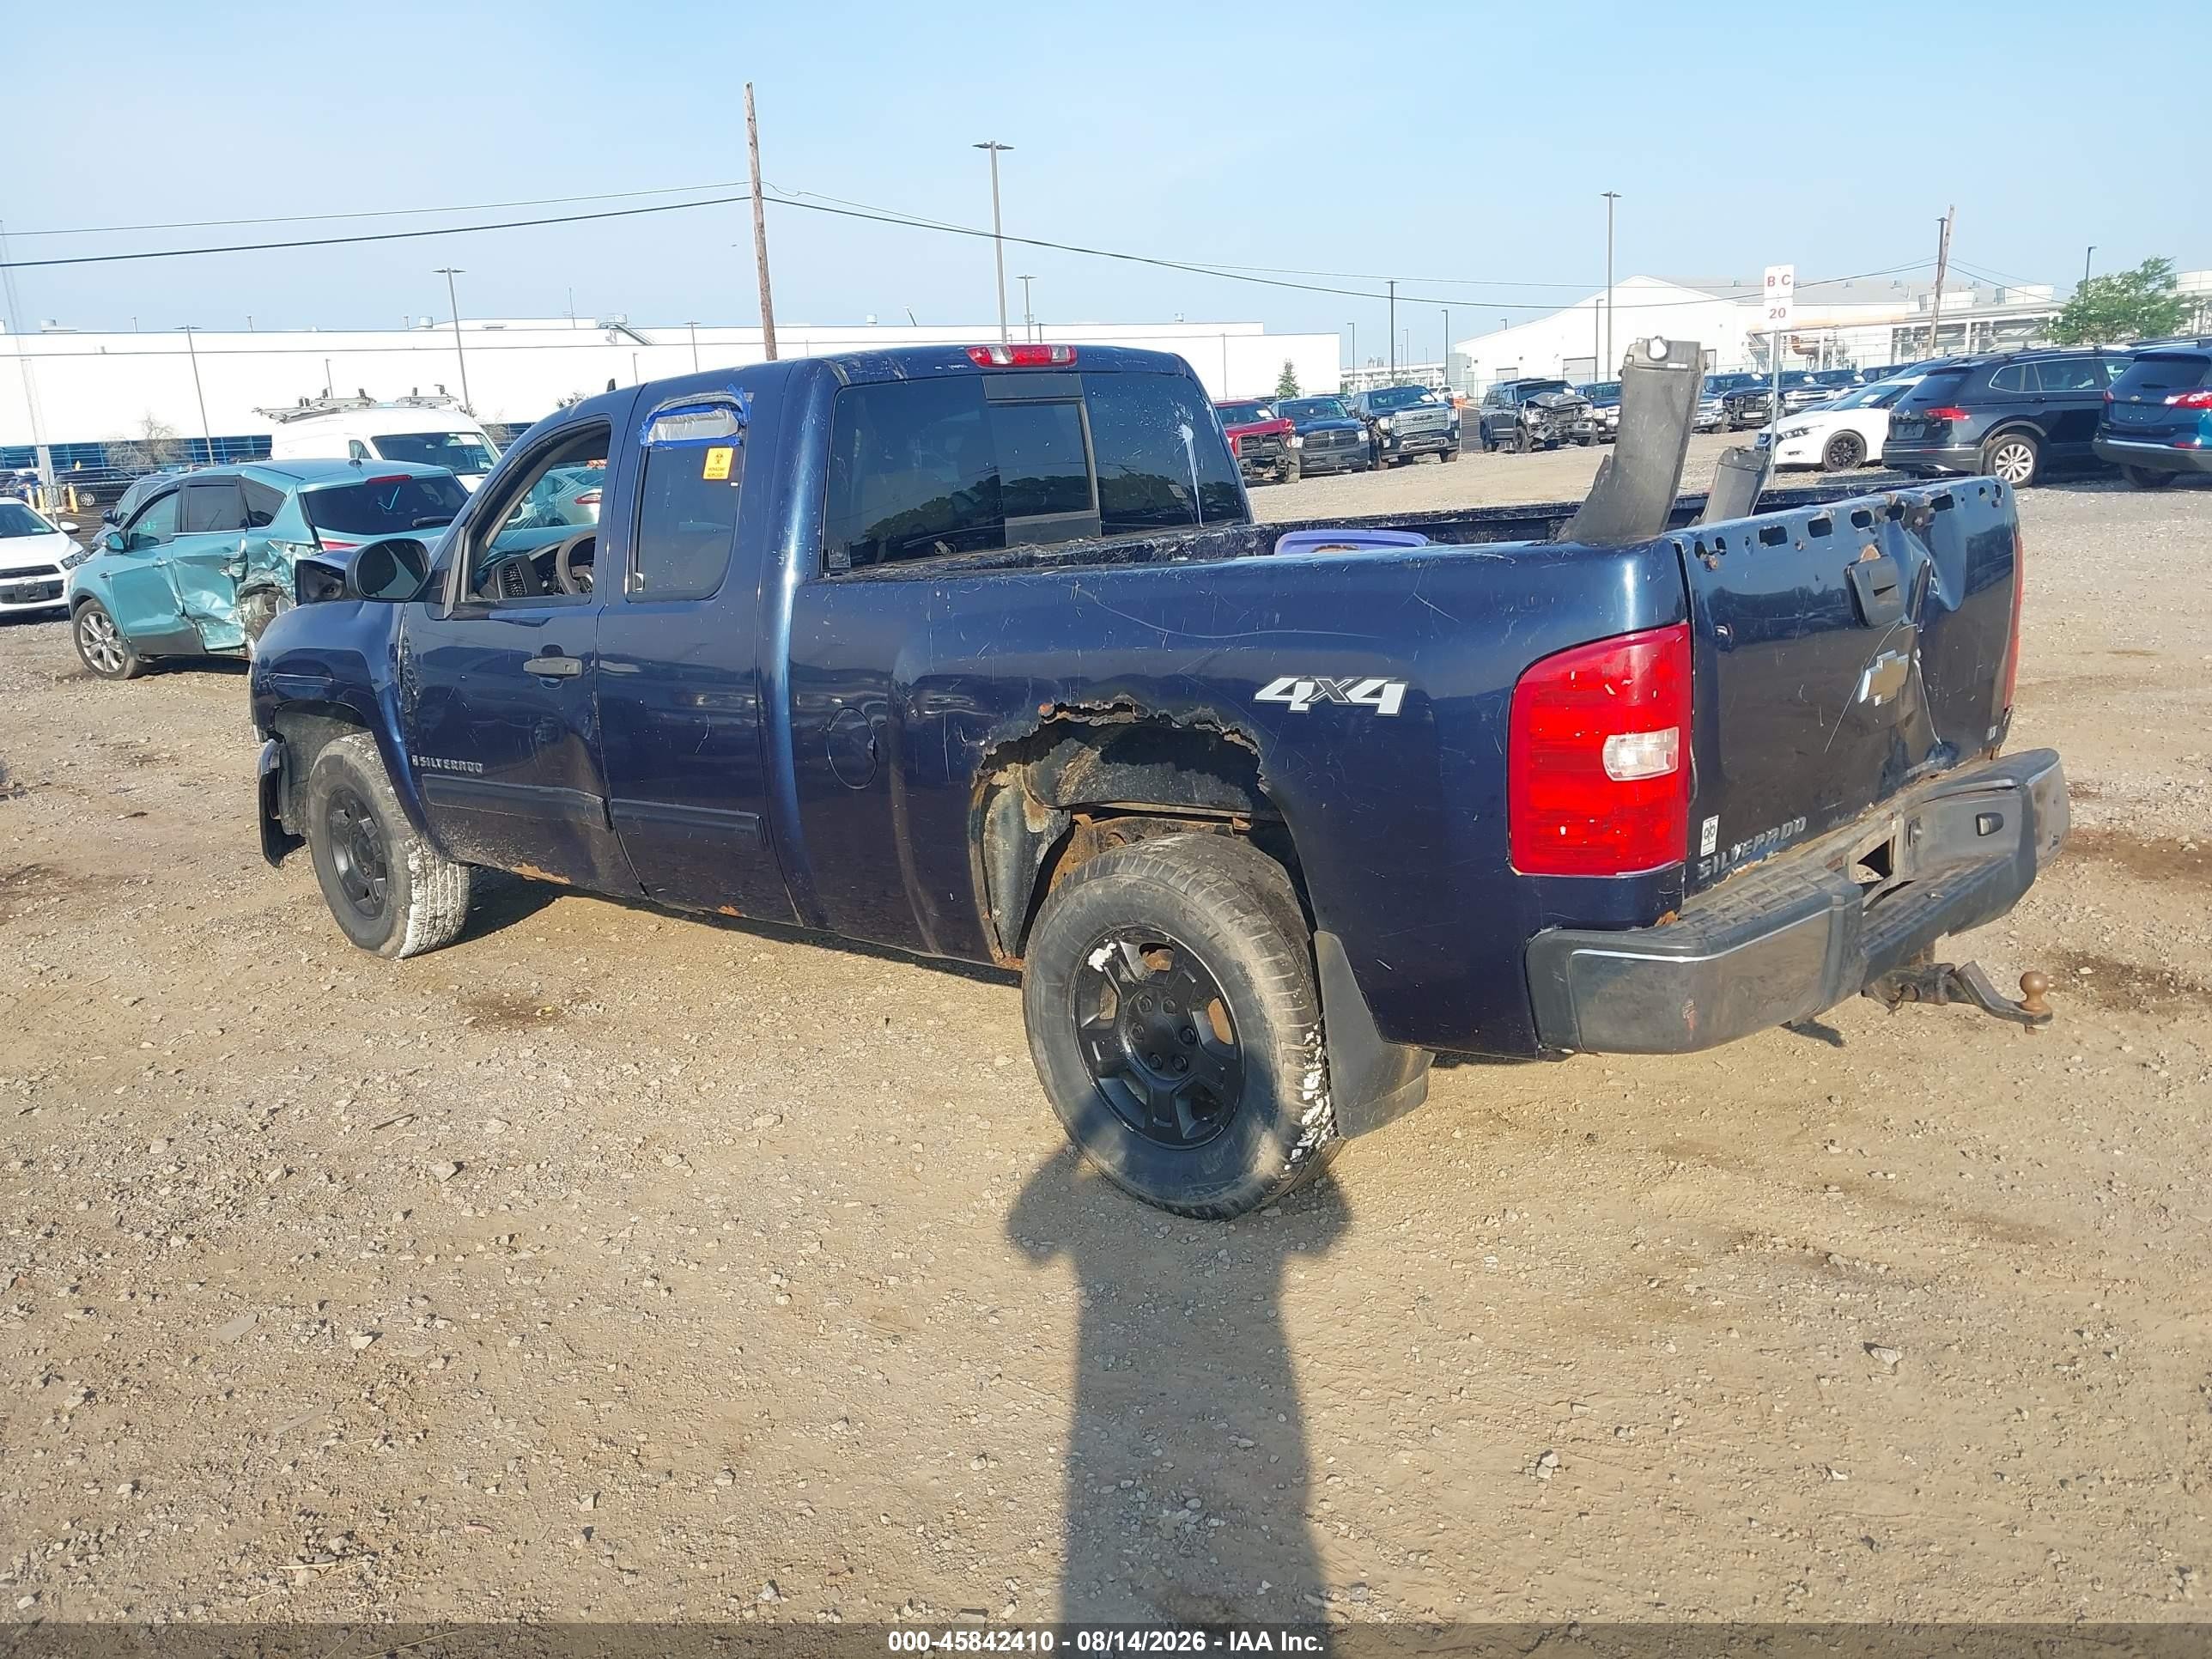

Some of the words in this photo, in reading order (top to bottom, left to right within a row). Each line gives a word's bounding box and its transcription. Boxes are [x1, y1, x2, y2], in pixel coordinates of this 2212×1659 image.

[1767, 276, 1776, 288] B
[1781, 274, 1791, 286] C
[1769, 307, 1786, 319] 20
[419, 756, 483, 774] SILVERADO
